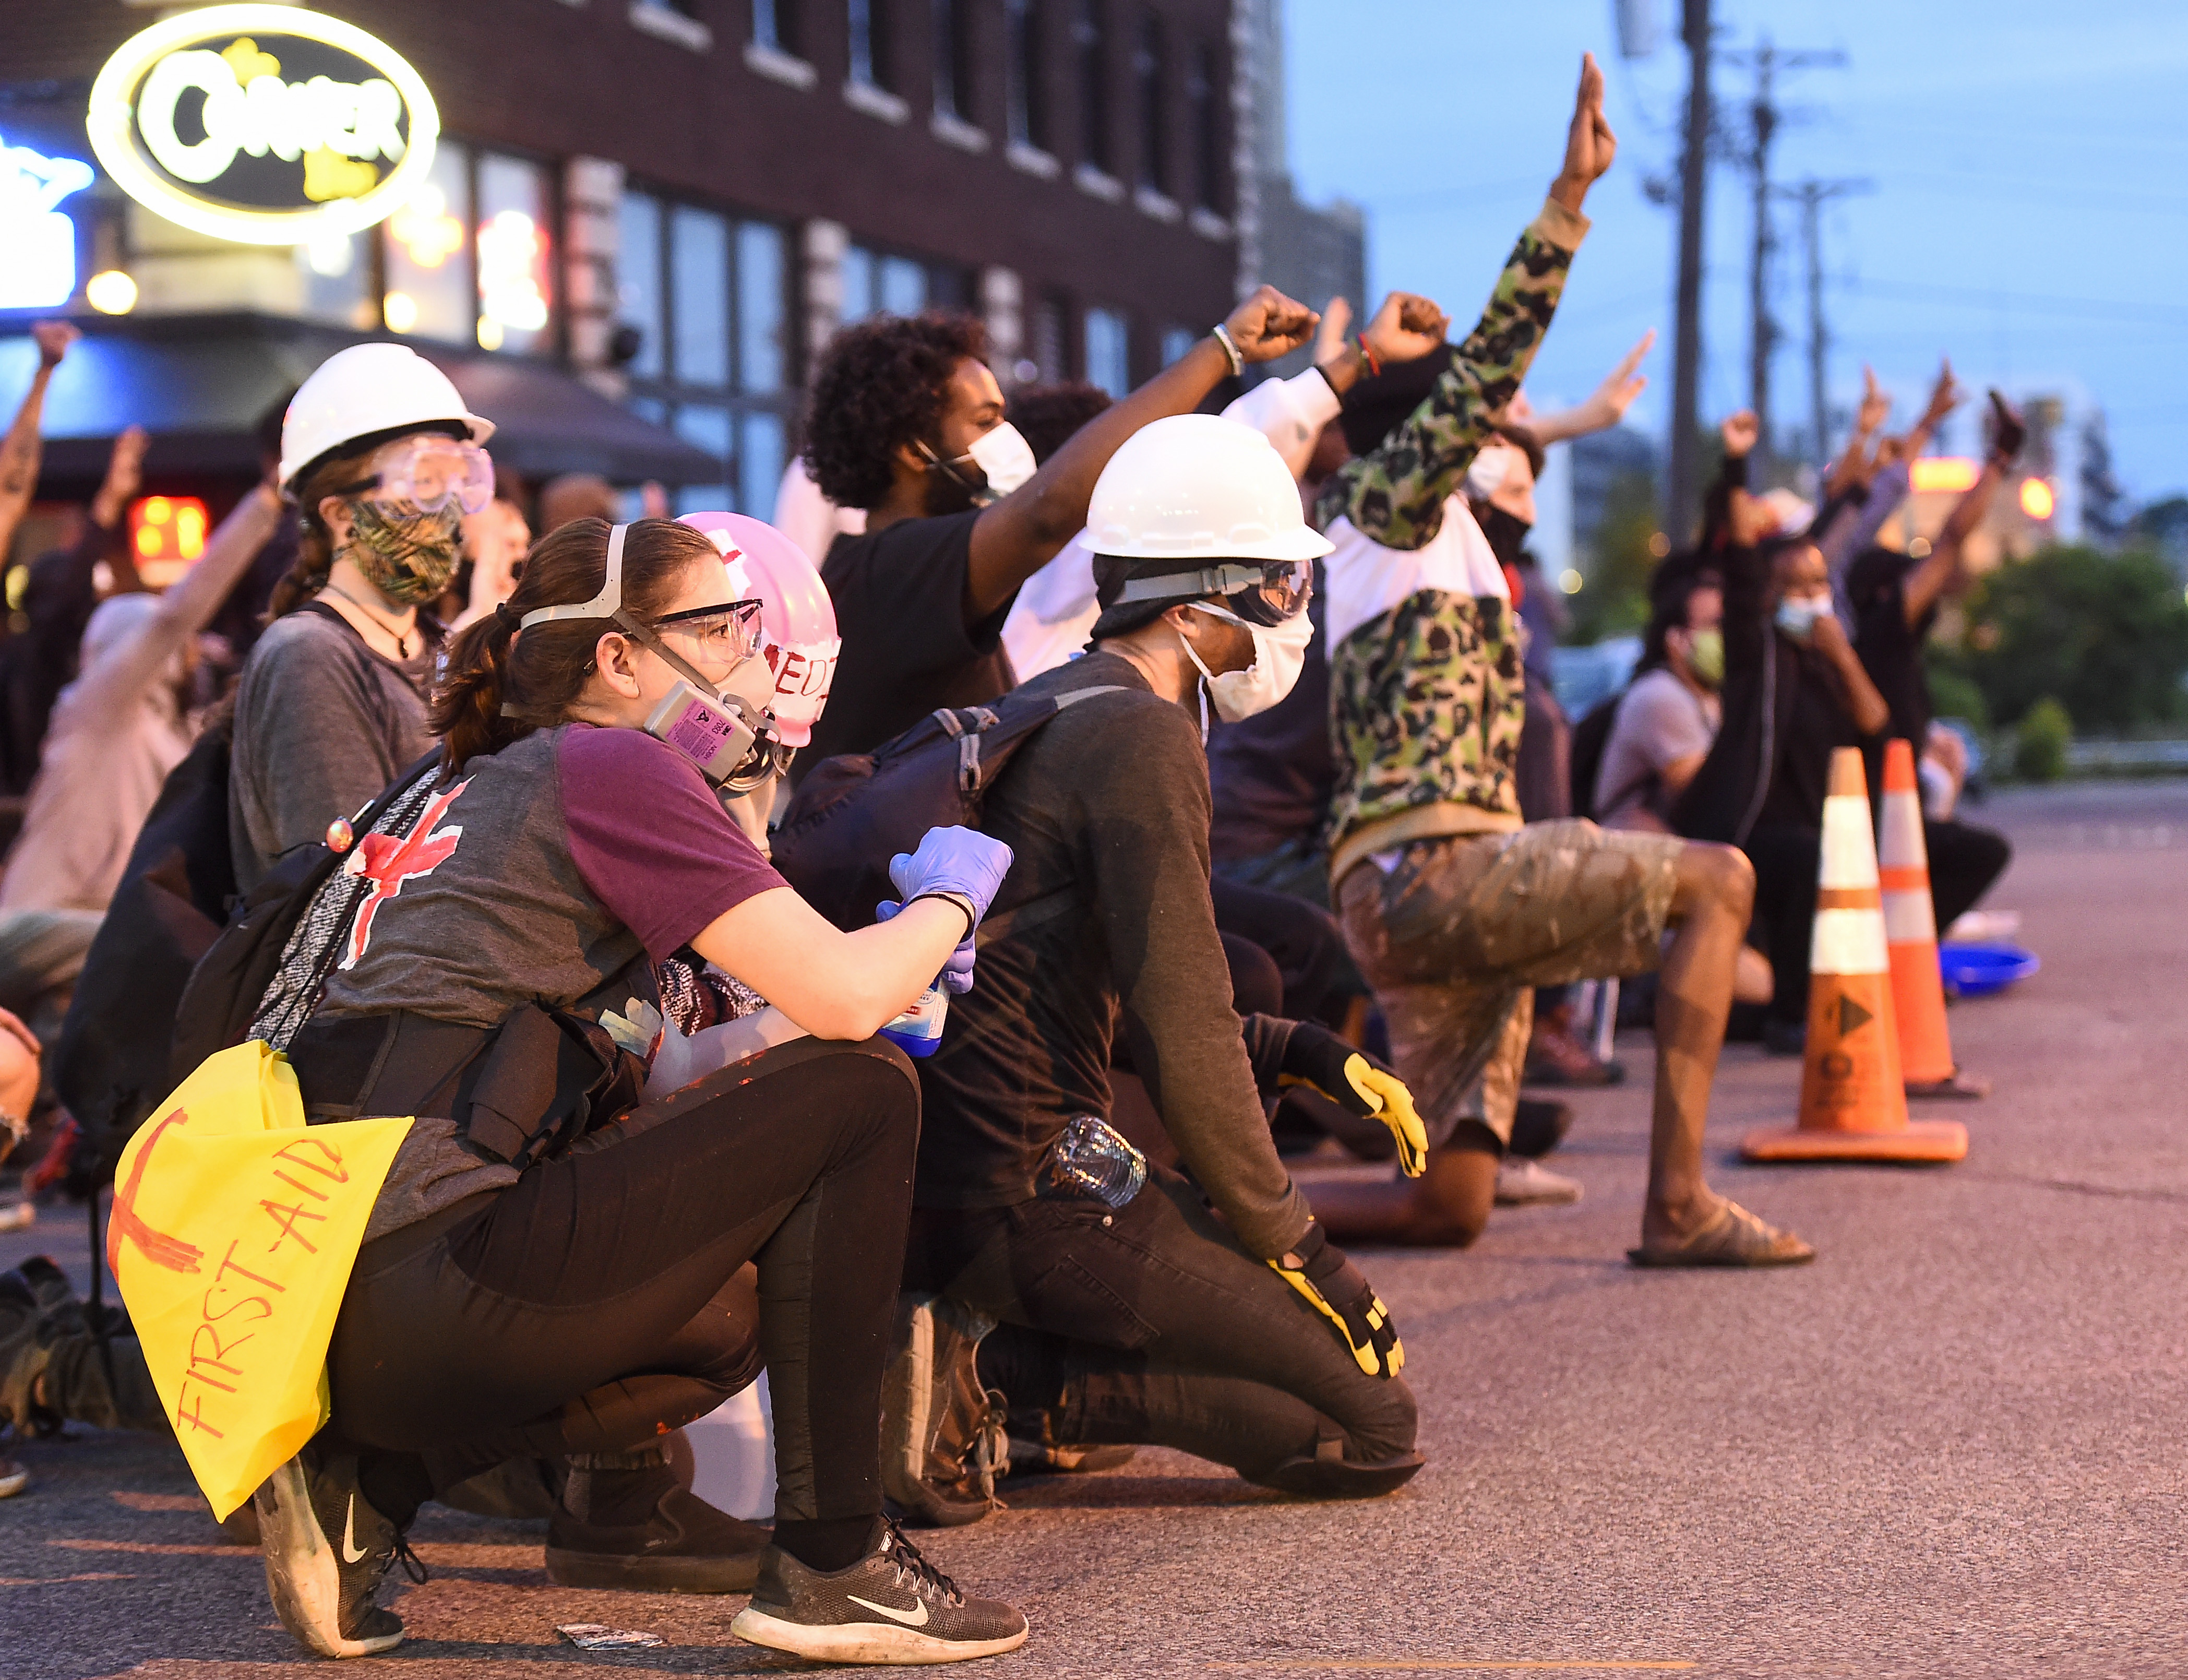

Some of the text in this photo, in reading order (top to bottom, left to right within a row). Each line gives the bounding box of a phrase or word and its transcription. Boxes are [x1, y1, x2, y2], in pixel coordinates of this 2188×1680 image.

[712, 720, 726, 734] 7093
[721, 725, 732, 736] 3M
[177, 1239, 286, 1439] FIRST
